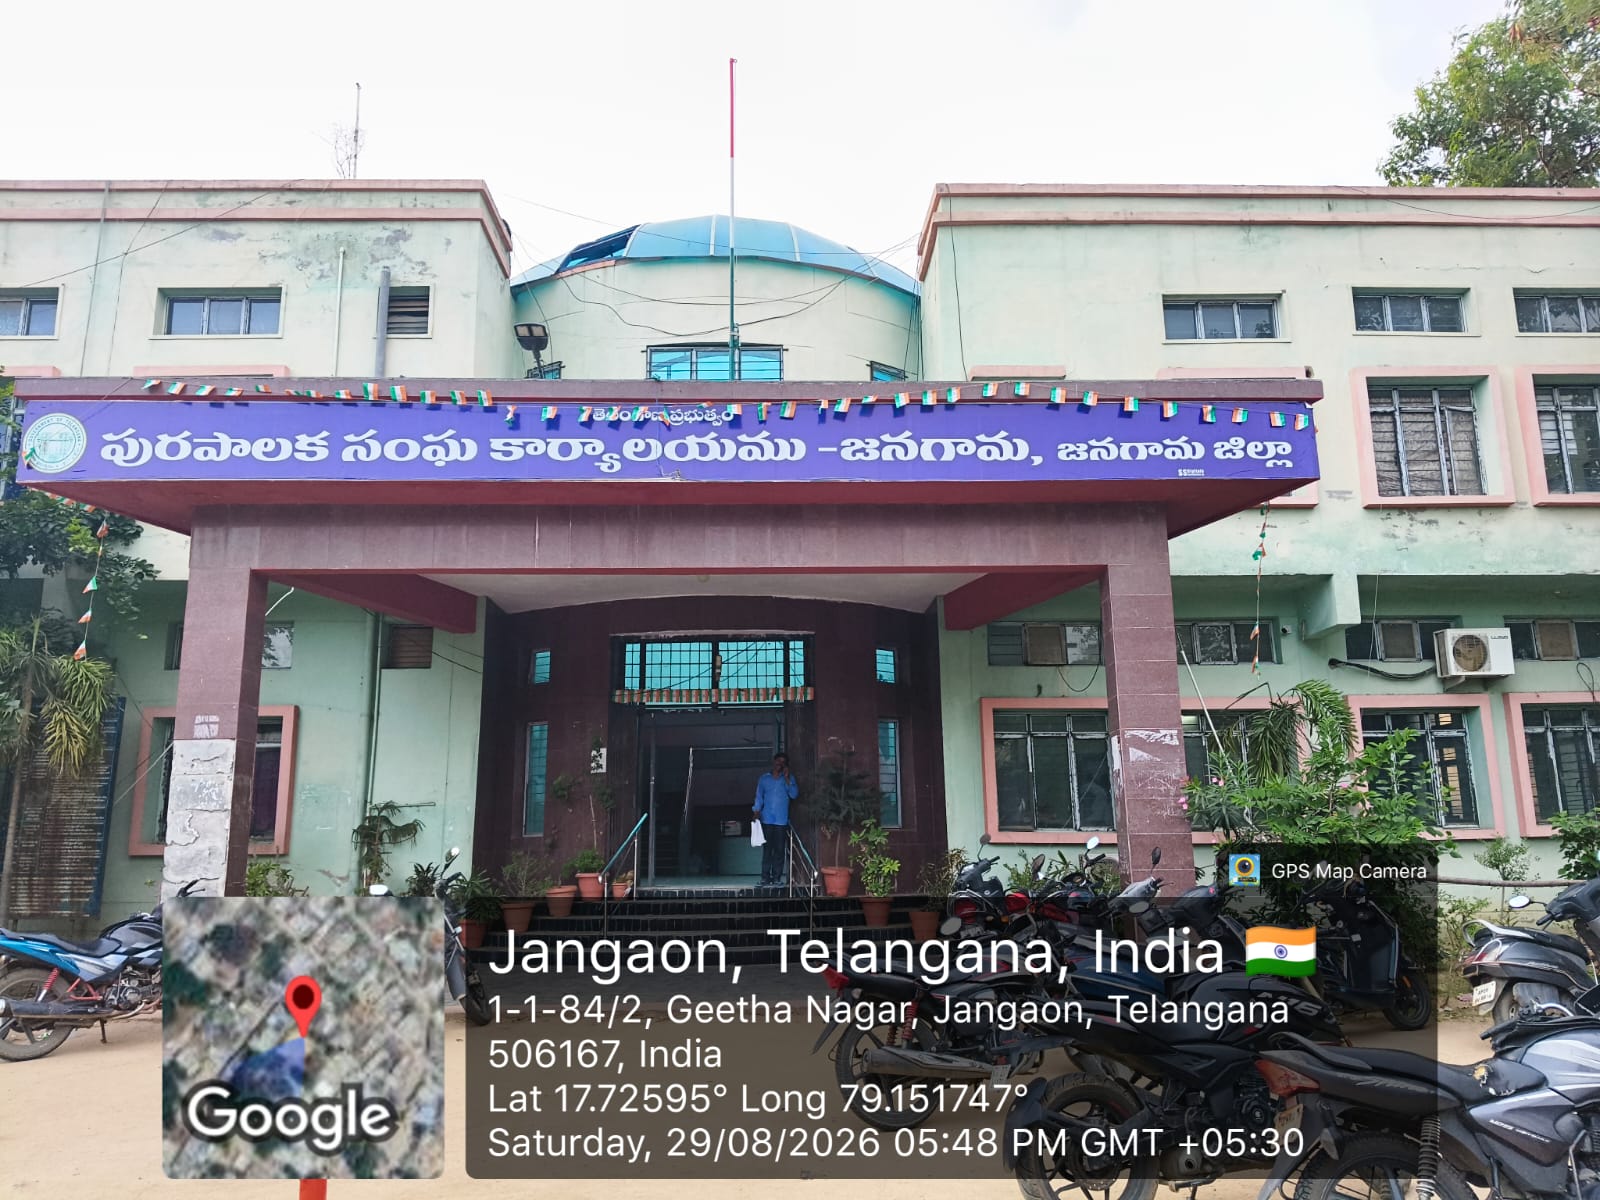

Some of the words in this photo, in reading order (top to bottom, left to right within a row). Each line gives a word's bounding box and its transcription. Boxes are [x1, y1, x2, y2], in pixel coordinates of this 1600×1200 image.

[101, 428, 330, 468] పురపాలక
[342, 429, 478, 467] సంఘ
[490, 429, 806, 473] కార్యాలయము
[1057, 436, 1206, 461] జనగామ
[1213, 436, 1293, 468] జిల్లా
